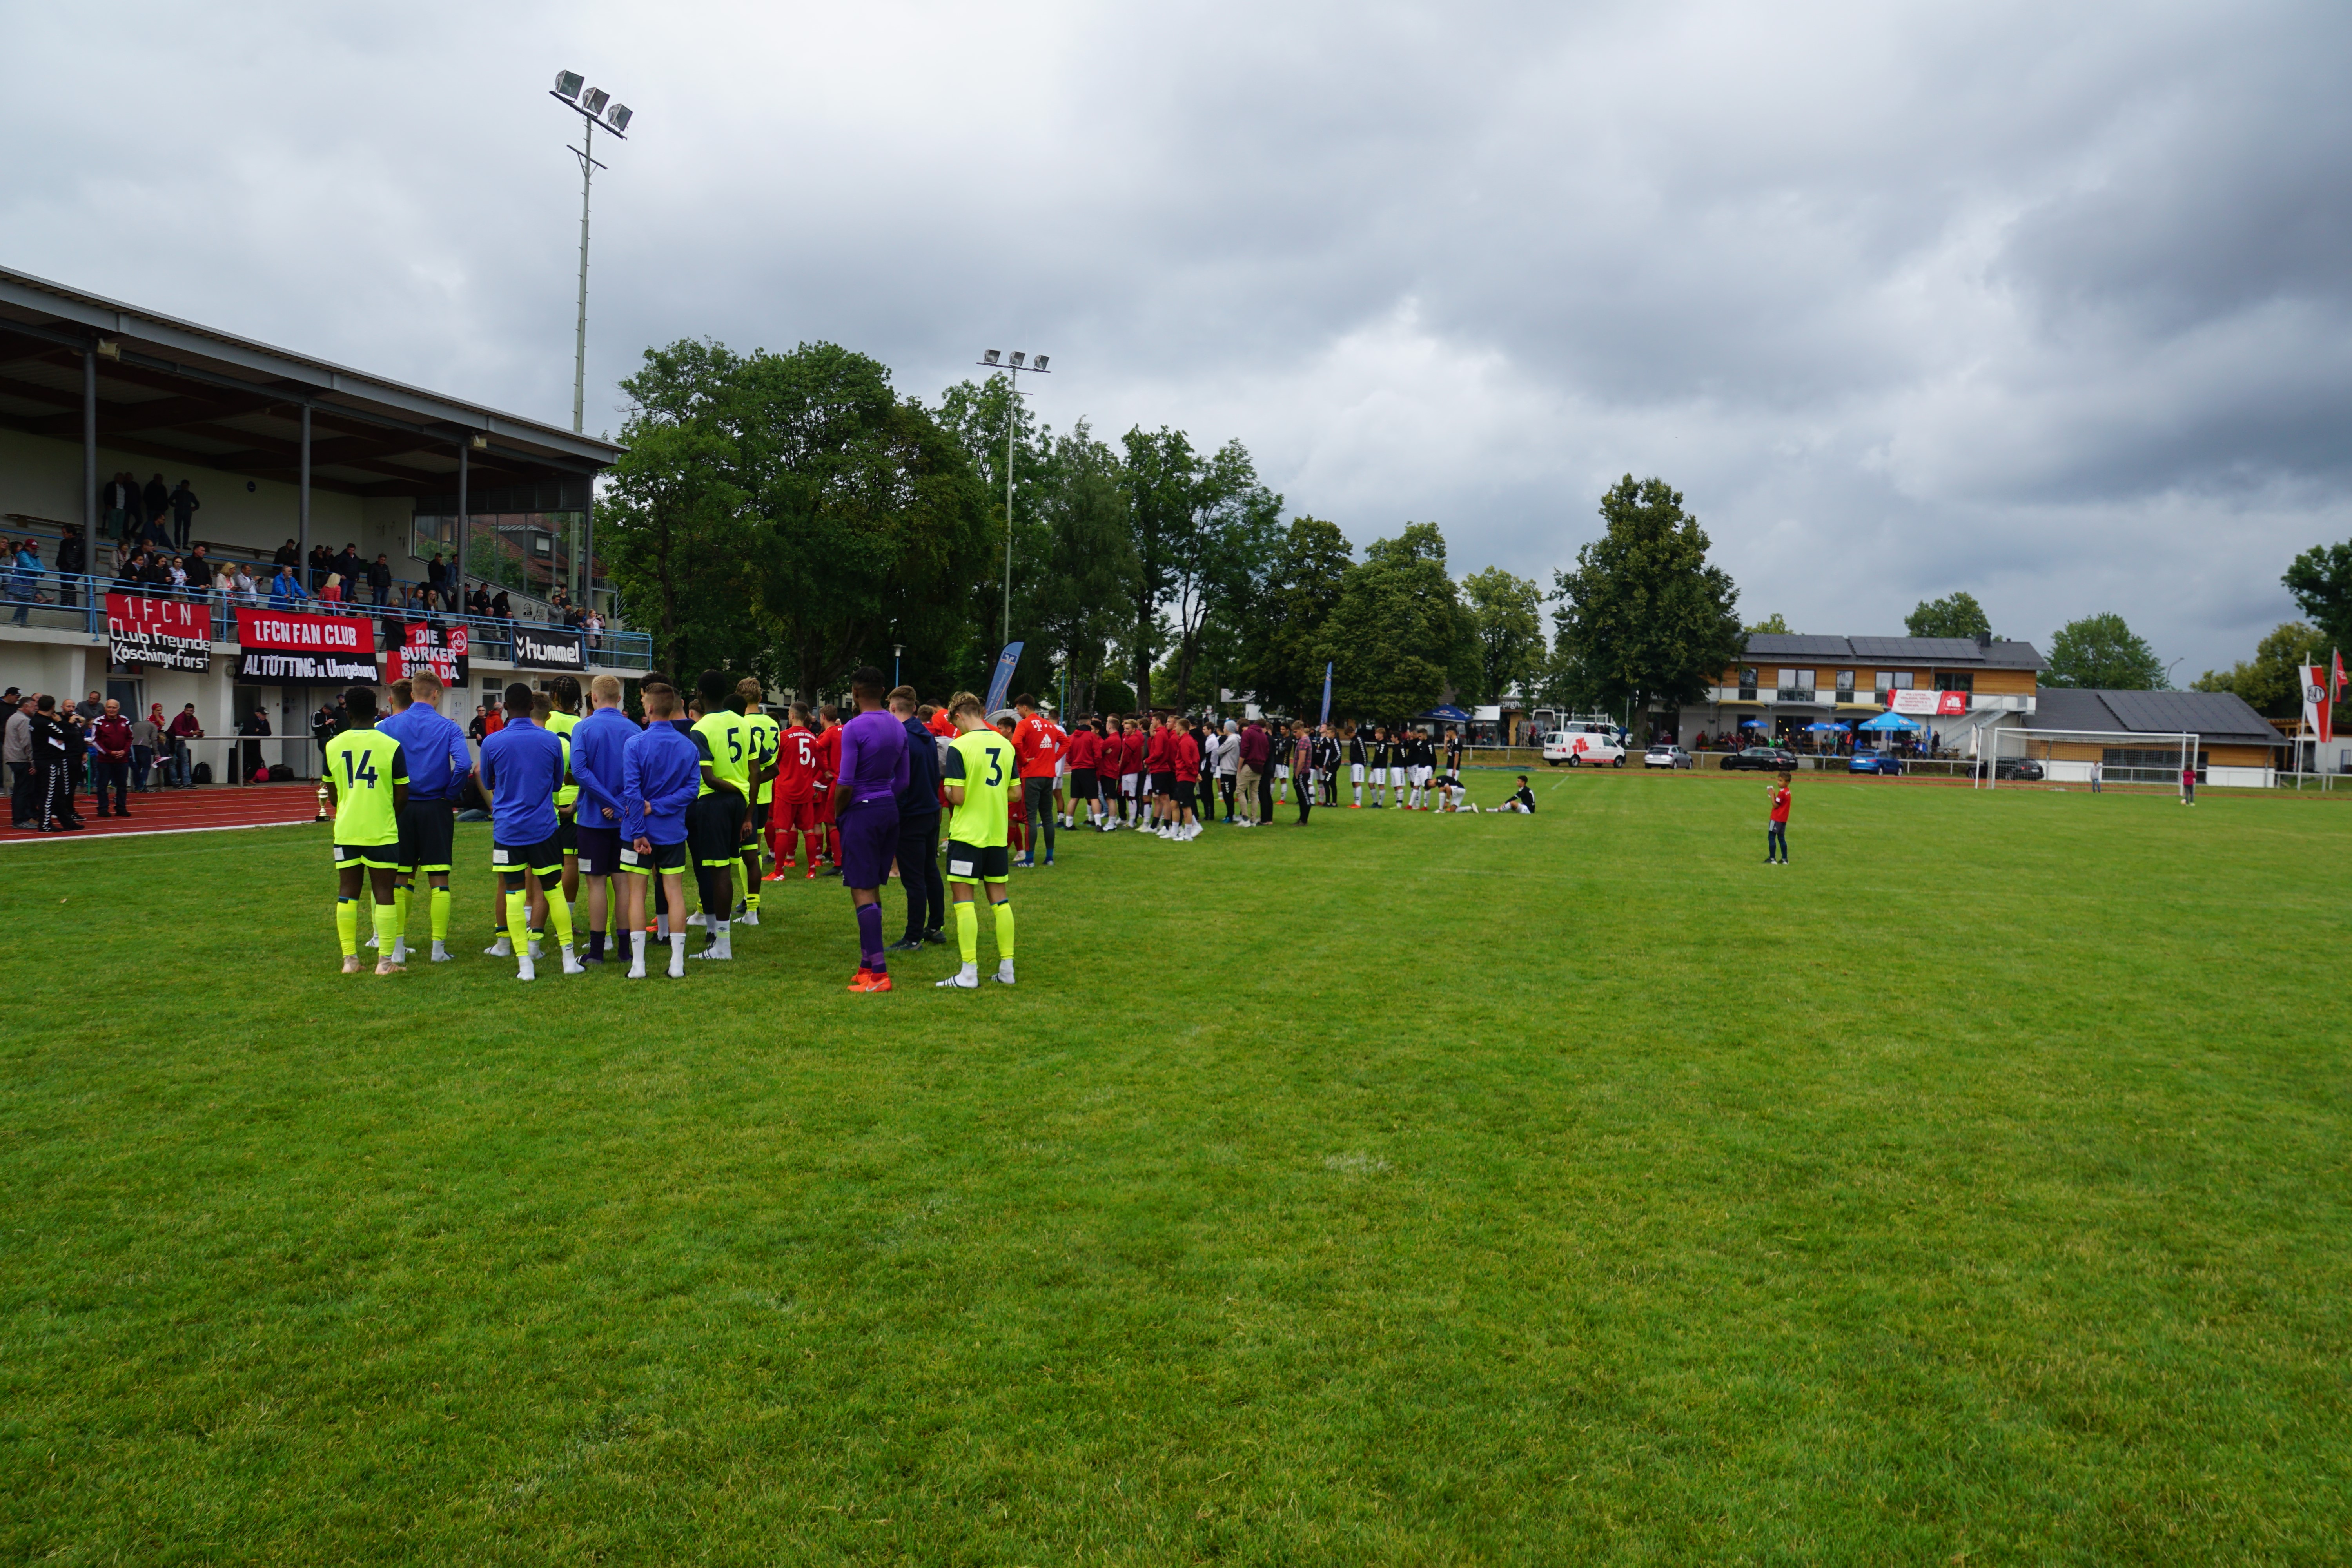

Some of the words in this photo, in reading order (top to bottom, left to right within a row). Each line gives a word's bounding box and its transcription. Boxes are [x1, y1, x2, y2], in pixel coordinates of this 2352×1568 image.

[152, 624, 211, 652] Freunde
[254, 620, 290, 643] 1.FCN
[293, 624, 321, 644] FAN
[325, 624, 357, 646] CLUB
[416, 629, 439, 645] DIE
[111, 641, 210, 670] Köschingerforst
[399, 646, 458, 664] BURKER
[526, 636, 580, 663] hummel
[243, 654, 316, 677] ALTÖTTING
[317, 664, 327, 678] u.
[326, 658, 378, 681] Umgebung
[440, 664, 461, 680] DA
[727, 726, 742, 764] 5
[799, 738, 811, 765] 5
[341, 750, 379, 789] 14
[985, 748, 1002, 787] 3
